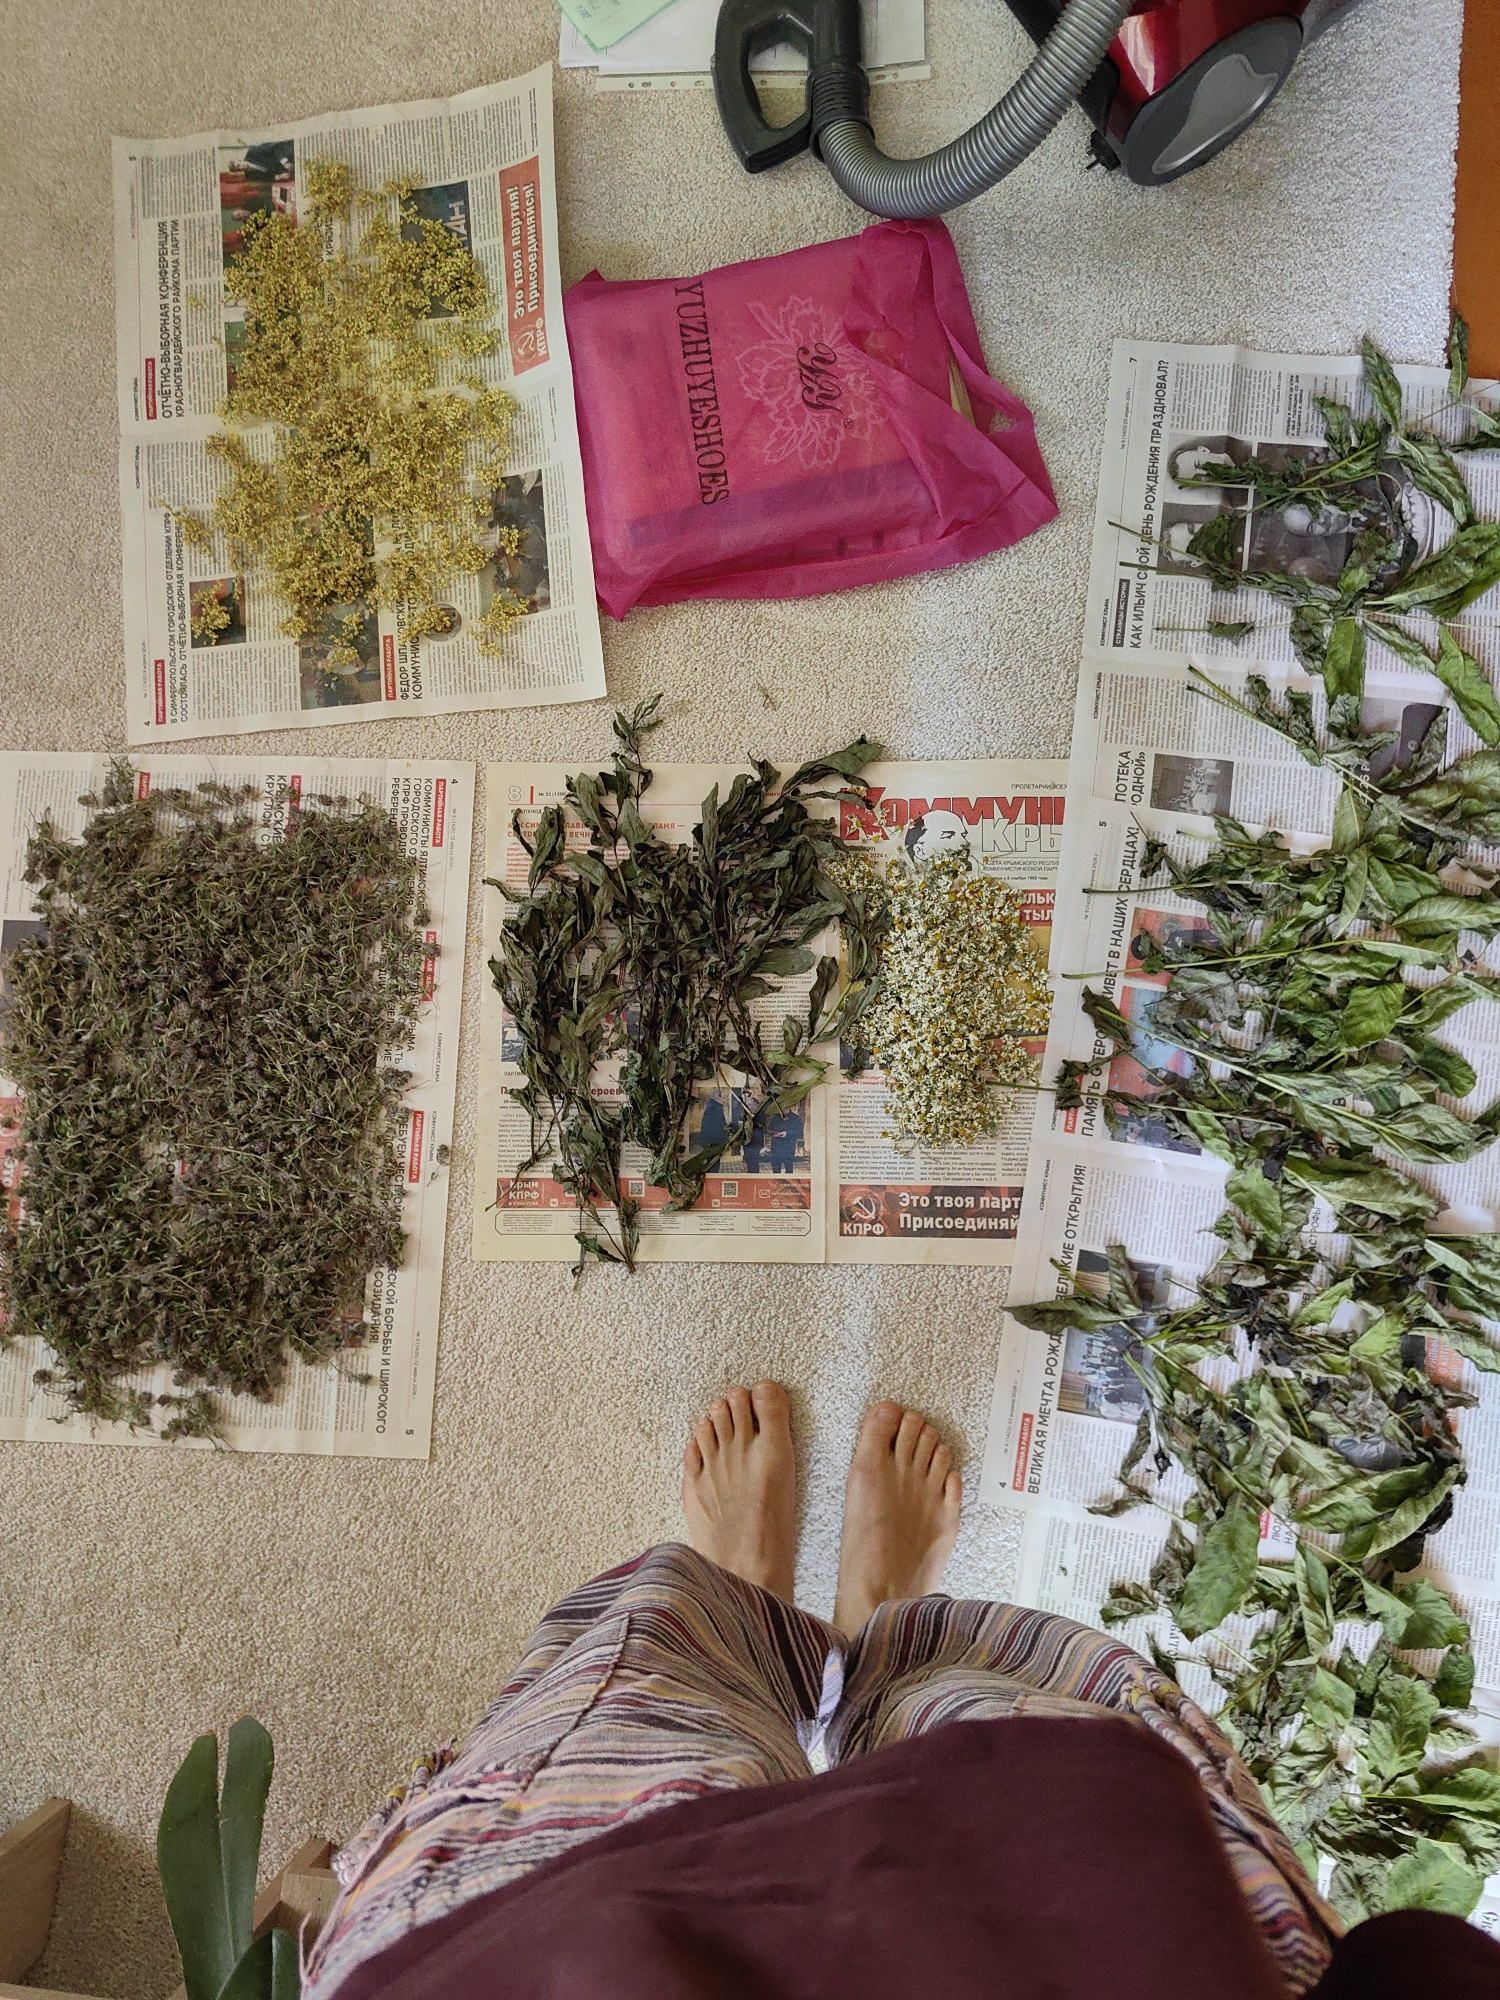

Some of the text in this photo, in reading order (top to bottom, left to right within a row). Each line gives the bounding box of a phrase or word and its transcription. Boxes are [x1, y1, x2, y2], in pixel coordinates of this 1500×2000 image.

[506, 185, 525, 319] Это твоя партия!
[523, 182, 540, 311] Присоединяйся!
[157, 221, 173, 418] ОТЧЁТНО-ВЫБОРНАЯ КОНФЕРЕНЦИЯ
[170, 220, 185, 417] КРАСНОГВАРДЕЙСКОГО РАЙКОМА ПАРТИИ
[535, 318, 548, 356] КПРФ
[675, 281, 730, 505] YUZHUYESHOES
[1151, 360, 1169, 443] ПРАЗДНОВАЛ?
[1143, 446, 1160, 510] РОЖДЕНИЯ
[163, 512, 172, 533] КПРФ
[165, 535, 174, 580] ОТДЕЛЕНИИ
[1135, 547, 1150, 580] СОЙ
[166, 582, 176, 633] ГОРОДСКОМ
[174, 573, 188, 661] ОТЧЁТНО-ВЫБОРНАЯ
[1116, 581, 1127, 644] СТРАНИЦЫ ИСТОРИИ
[1133, 583, 1147, 621] ИЛЬИЧ
[1129, 625, 1143, 648] КАК
[168, 634, 178, 716] СИМФЕРОПОЛЬСКОМ
[180, 663, 189, 722] СОСТОЯЛАСЬ
[399, 666, 410, 700] ФЕДОР
[411, 635, 423, 700] КОММУНИС
[508, 785, 522, 802] 8
[1115, 750, 1131, 802] ПОТЕКА
[1132, 751, 1146, 805] ОДНОЙ»
[389, 777, 399, 828] РЕФЕРЕНД
[398, 778, 410, 860] КПРФ ПРОВОДЯТ
[405, 778, 421, 905] ГОРОДСКОГО ОТЕНИЯ
[417, 778, 432, 910] КОММУНИСТЫ ЯЛТИНСКО
[1118, 827, 1139, 892] СЕРДЦАХ!
[1110, 897, 1128, 947] НАШИХ
[1108, 950, 1120, 959] В
[1102, 961, 1118, 1000] ИВЕТ
[591, 1086, 621, 1097] ероев
[414, 1113, 422, 1152] ПАРТИЙНАЯ
[509, 1180, 539, 1193] Крым
[509, 1191, 539, 1200] КПРФ
[899, 1192, 1020, 1211] Это твоя парт
[1065, 1165, 1086, 1239] ОТКРЫТИЯ!
[843, 1223, 885, 1235] КПРФ
[900, 1213, 1019, 1231] Присоединяй
[1309, 1207, 1322, 1251] АСТРОФЫ
[369, 1271, 384, 1343] СОЗИДАНИЯ!
[382, 1308, 394, 1355] БОРЬБЫ
[381, 1358, 390, 1366] И
[1045, 1333, 1063, 1376] РОЖД
[376, 1369, 389, 1434] ШИРОКОГО
[1037, 1380, 1055, 1426] МЕЧТА
[1016, 1417, 1030, 1487] ПАРТИЙНАЯ РАБОТА
[1028, 1429, 1048, 1494] ВЕЛИКАЯ
